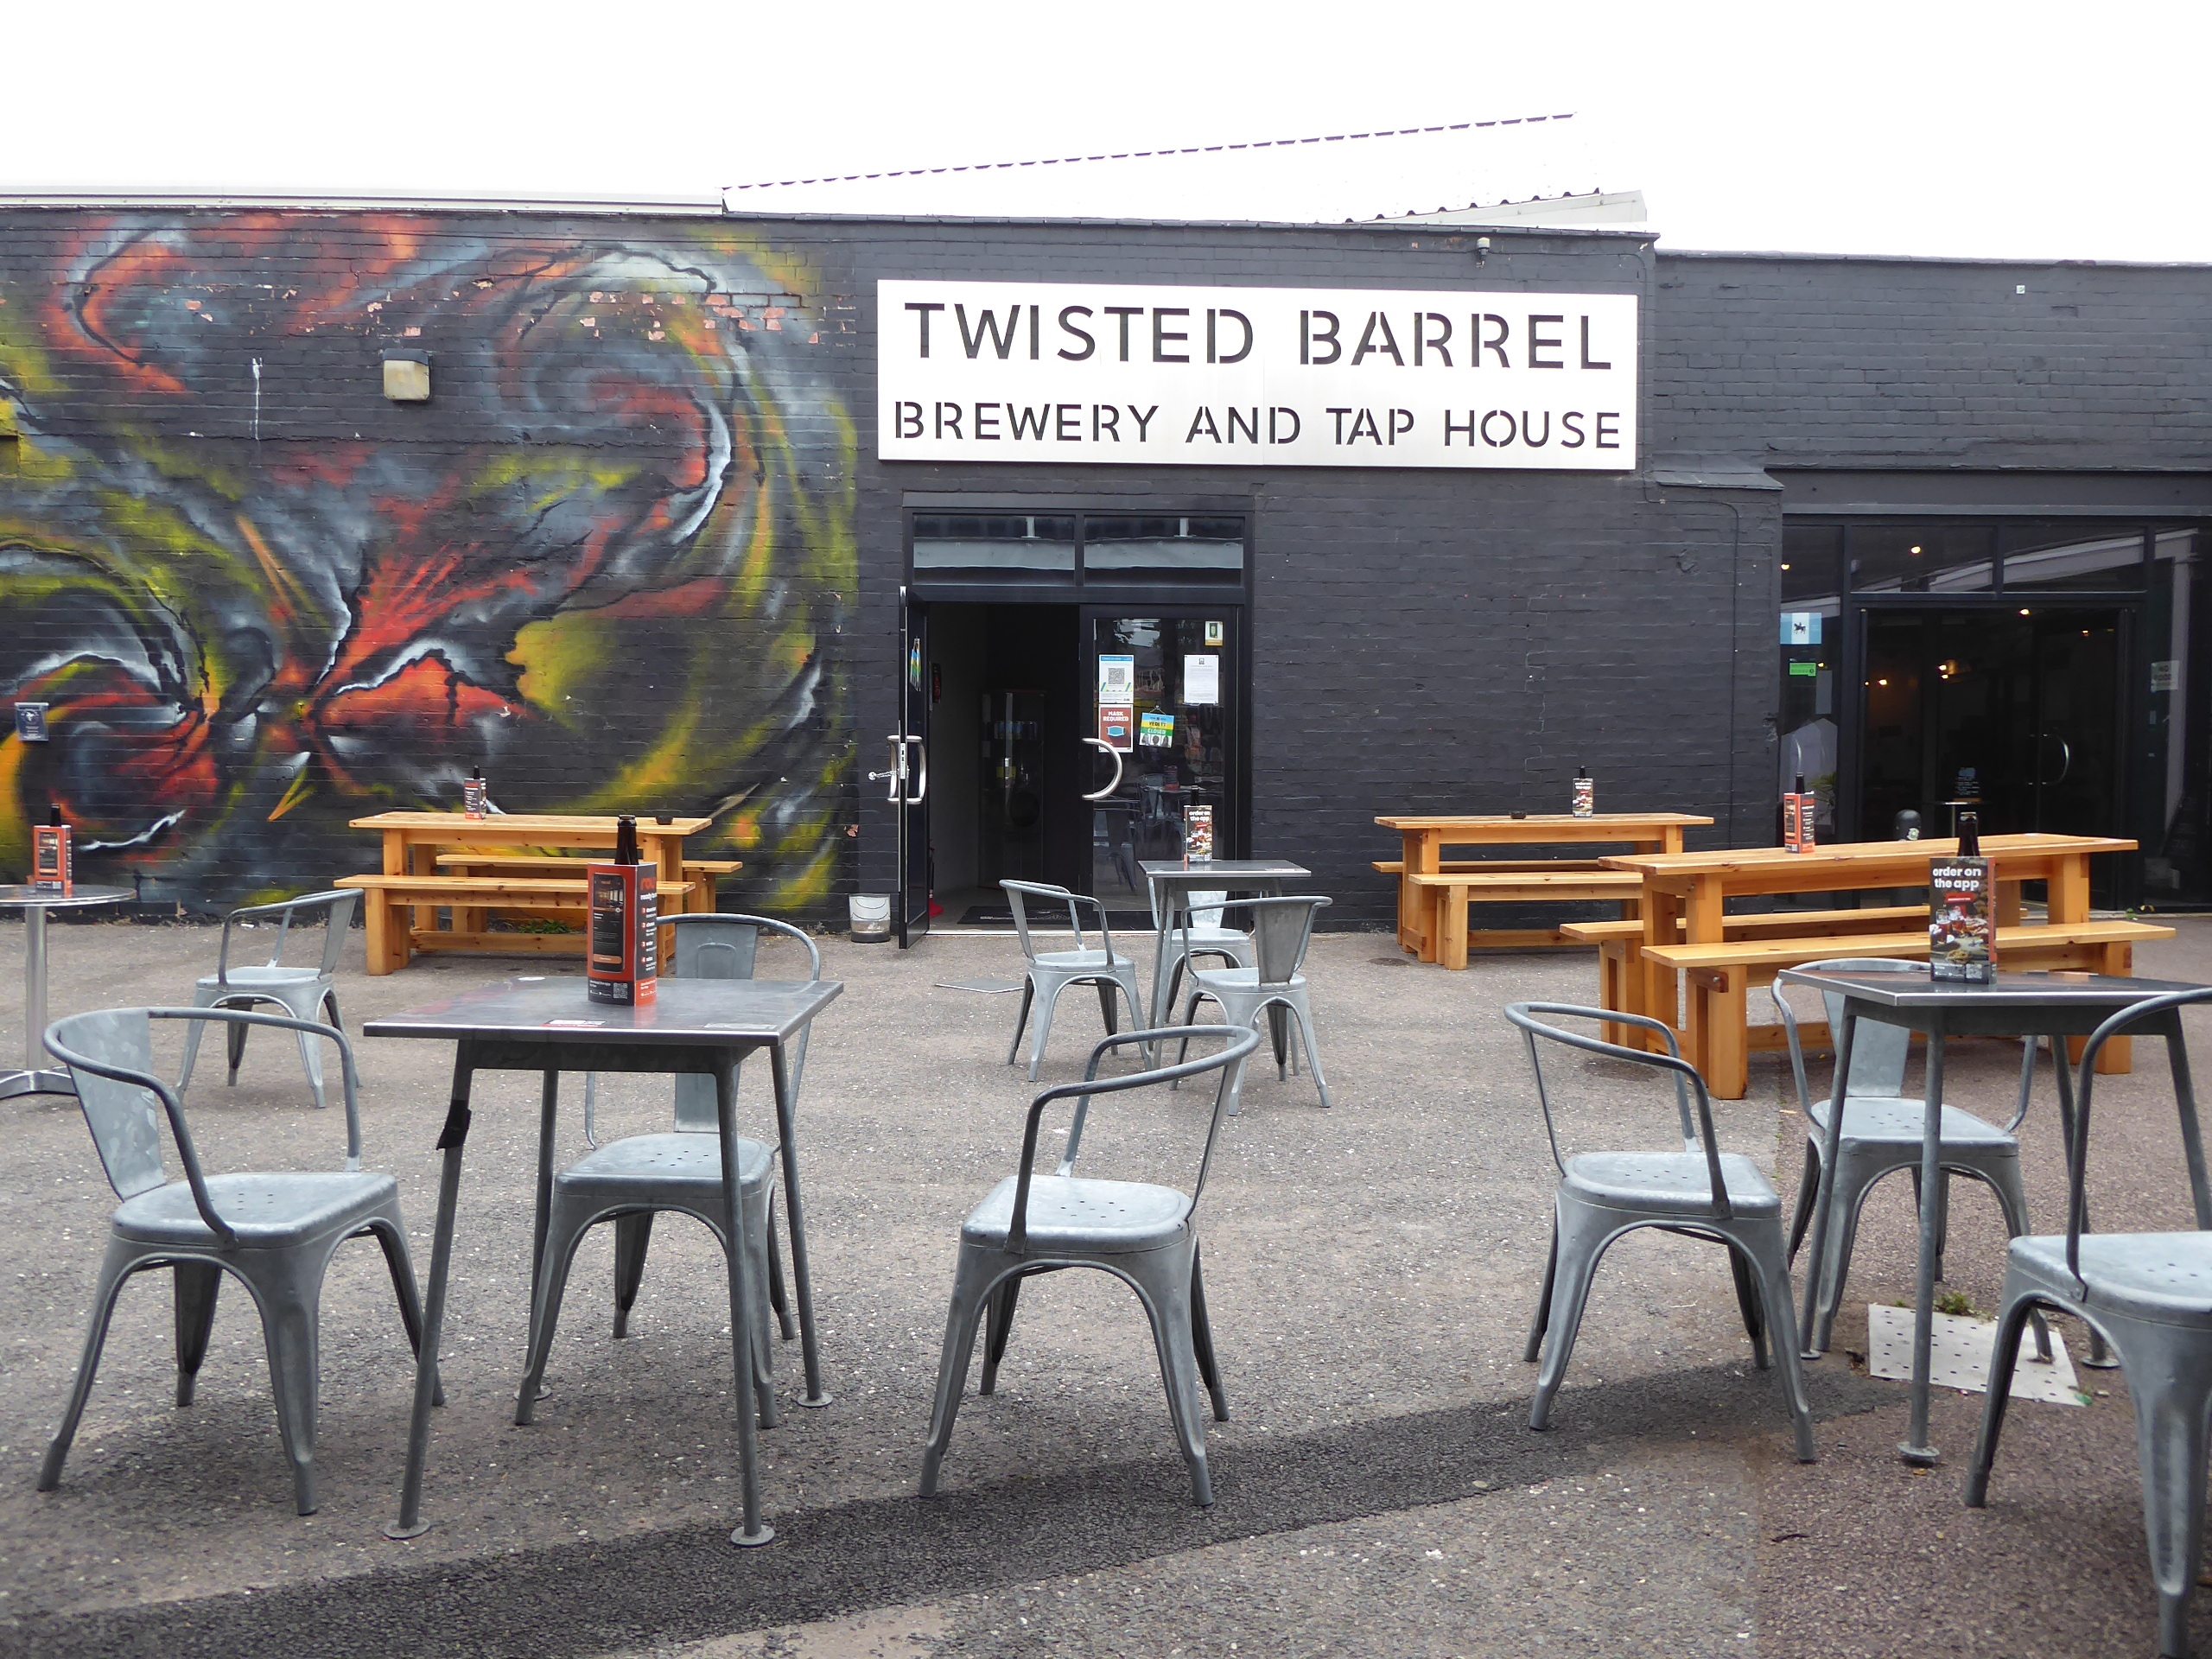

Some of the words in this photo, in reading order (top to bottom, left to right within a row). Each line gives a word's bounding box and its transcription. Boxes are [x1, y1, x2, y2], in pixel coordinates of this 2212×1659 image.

[904, 302, 1254, 364] TWISTED
[1300, 309, 1611, 370] BARREL
[895, 401, 1160, 442] BREWERY
[1185, 406, 1300, 444] AND
[1325, 407, 1414, 446] TAP
[1444, 409, 1620, 448] HOUSE
[1932, 866, 1963, 877] order
[1964, 868, 1982, 877] on
[1934, 878, 1953, 888] the
[1953, 880, 1980, 892] app
